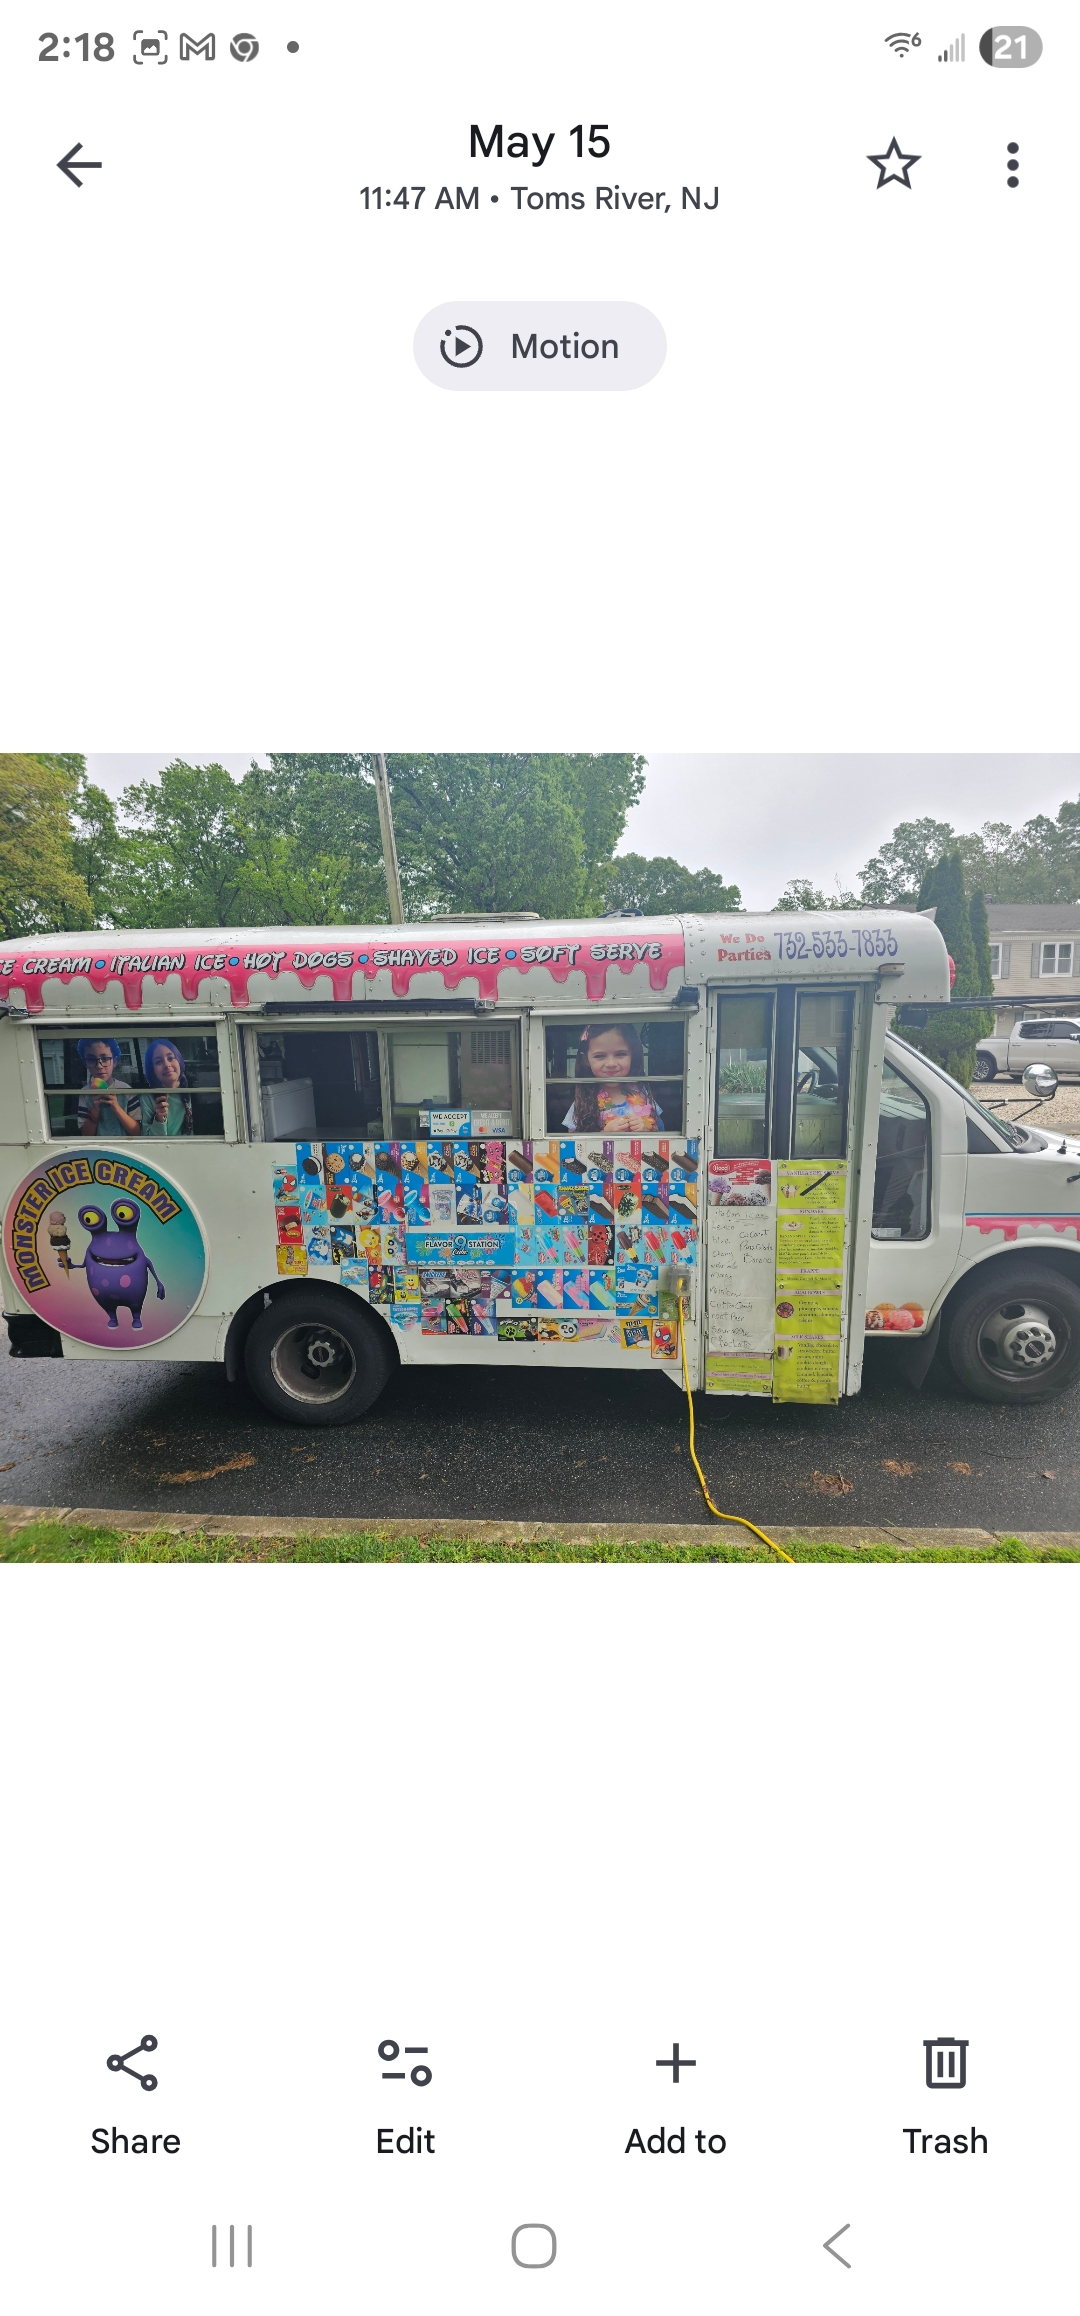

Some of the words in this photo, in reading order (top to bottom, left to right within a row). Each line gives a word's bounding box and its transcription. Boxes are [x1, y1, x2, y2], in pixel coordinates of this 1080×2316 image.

[720, 934, 740, 944] We
[745, 933, 764, 943] Do
[774, 928, 899, 960] 732-533-7833
[22, 956, 93, 974] CREAM
[110, 954, 186, 975] ITALIAN
[194, 953, 227, 971] ICE
[243, 951, 286, 972] HOT
[293, 950, 354, 969] DOGS
[373, 948, 458, 967] SHAVED
[467, 947, 501, 965] ICE
[520, 943, 581, 965] SOFT
[590, 942, 662, 961] SERVE
[717, 948, 772, 962] Parties
[47, 1160, 93, 1192] ICE
[95, 1160, 180, 1223] CREAM
[14, 1180, 57, 1291] MONSTER
[468, 1240, 499, 1248] STATION
